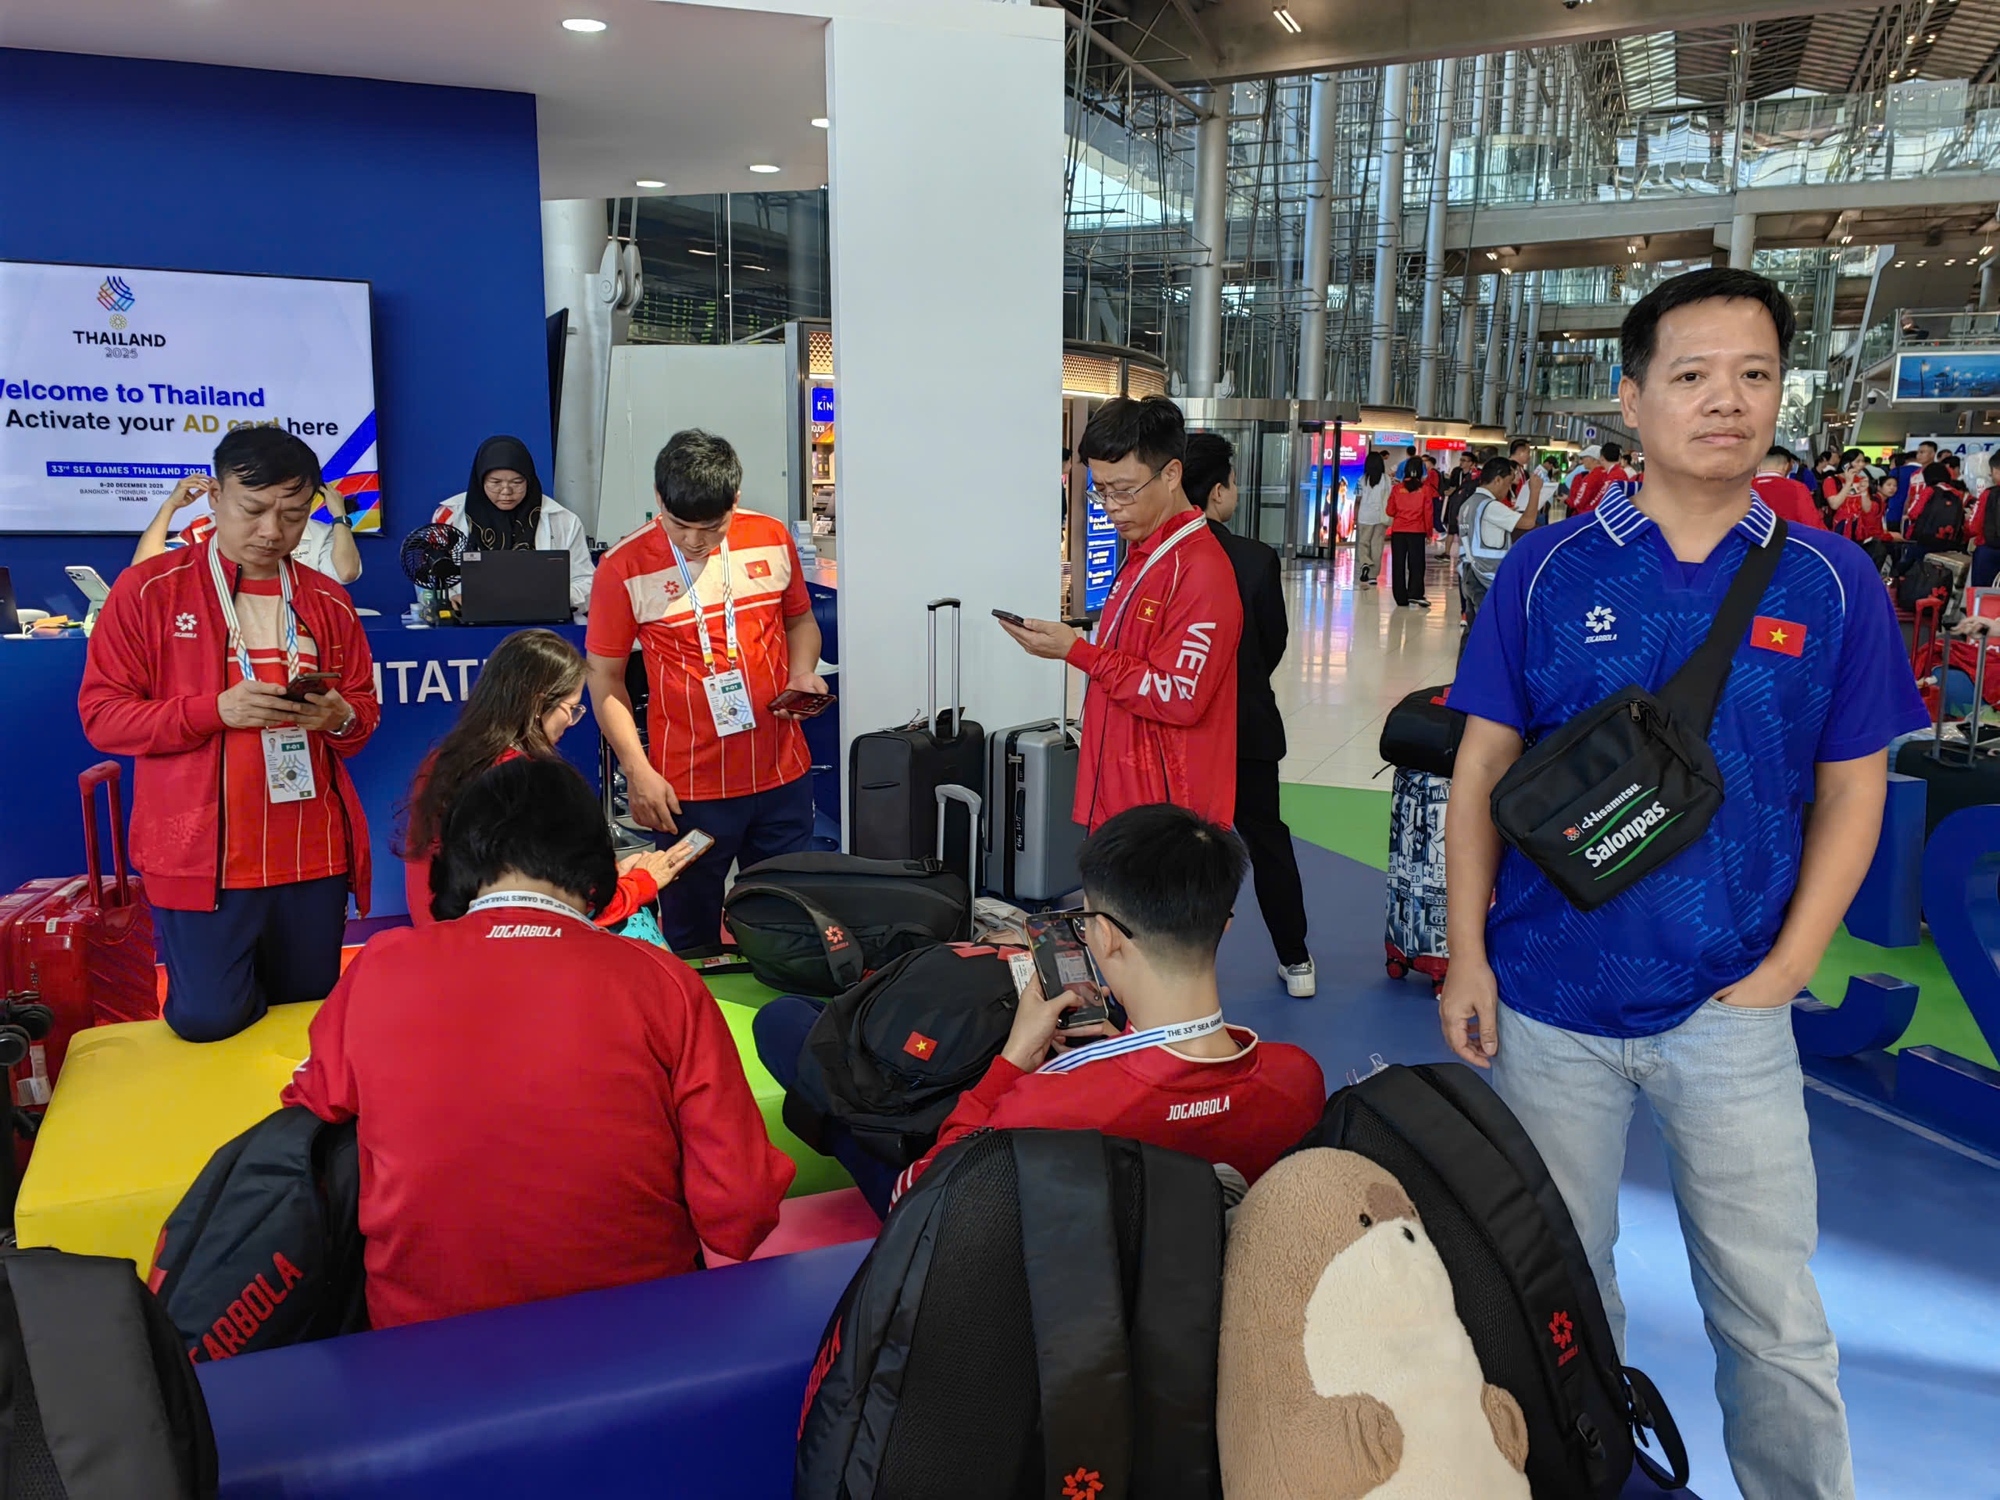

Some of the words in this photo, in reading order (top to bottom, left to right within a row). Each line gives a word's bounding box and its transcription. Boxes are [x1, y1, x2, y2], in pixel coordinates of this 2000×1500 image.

[73, 331, 166, 348] THAILAND
[104, 347, 139, 359] 2025
[116, 383, 144, 403] to
[148, 384, 265, 407] Thailand
[817, 401, 834, 411] KIN
[6, 409, 111, 430] Activate
[118, 415, 175, 435] your
[183, 414, 220, 433] AD
[287, 417, 339, 436] here
[73, 465, 92, 474] SEA
[95, 466, 129, 475] GAMES
[132, 466, 181, 475] THAILAND
[285, 743, 301, 751] F-01
[1584, 800, 1668, 869] Salonpas
[511, 895, 539, 904] GAMES
[486, 924, 562, 938] JOGARBOLA
[1167, 1028, 1182, 1038] THE
[1197, 1022, 1210, 1032] SEA
[1165, 1095, 1231, 1122] JOGARBOLA
